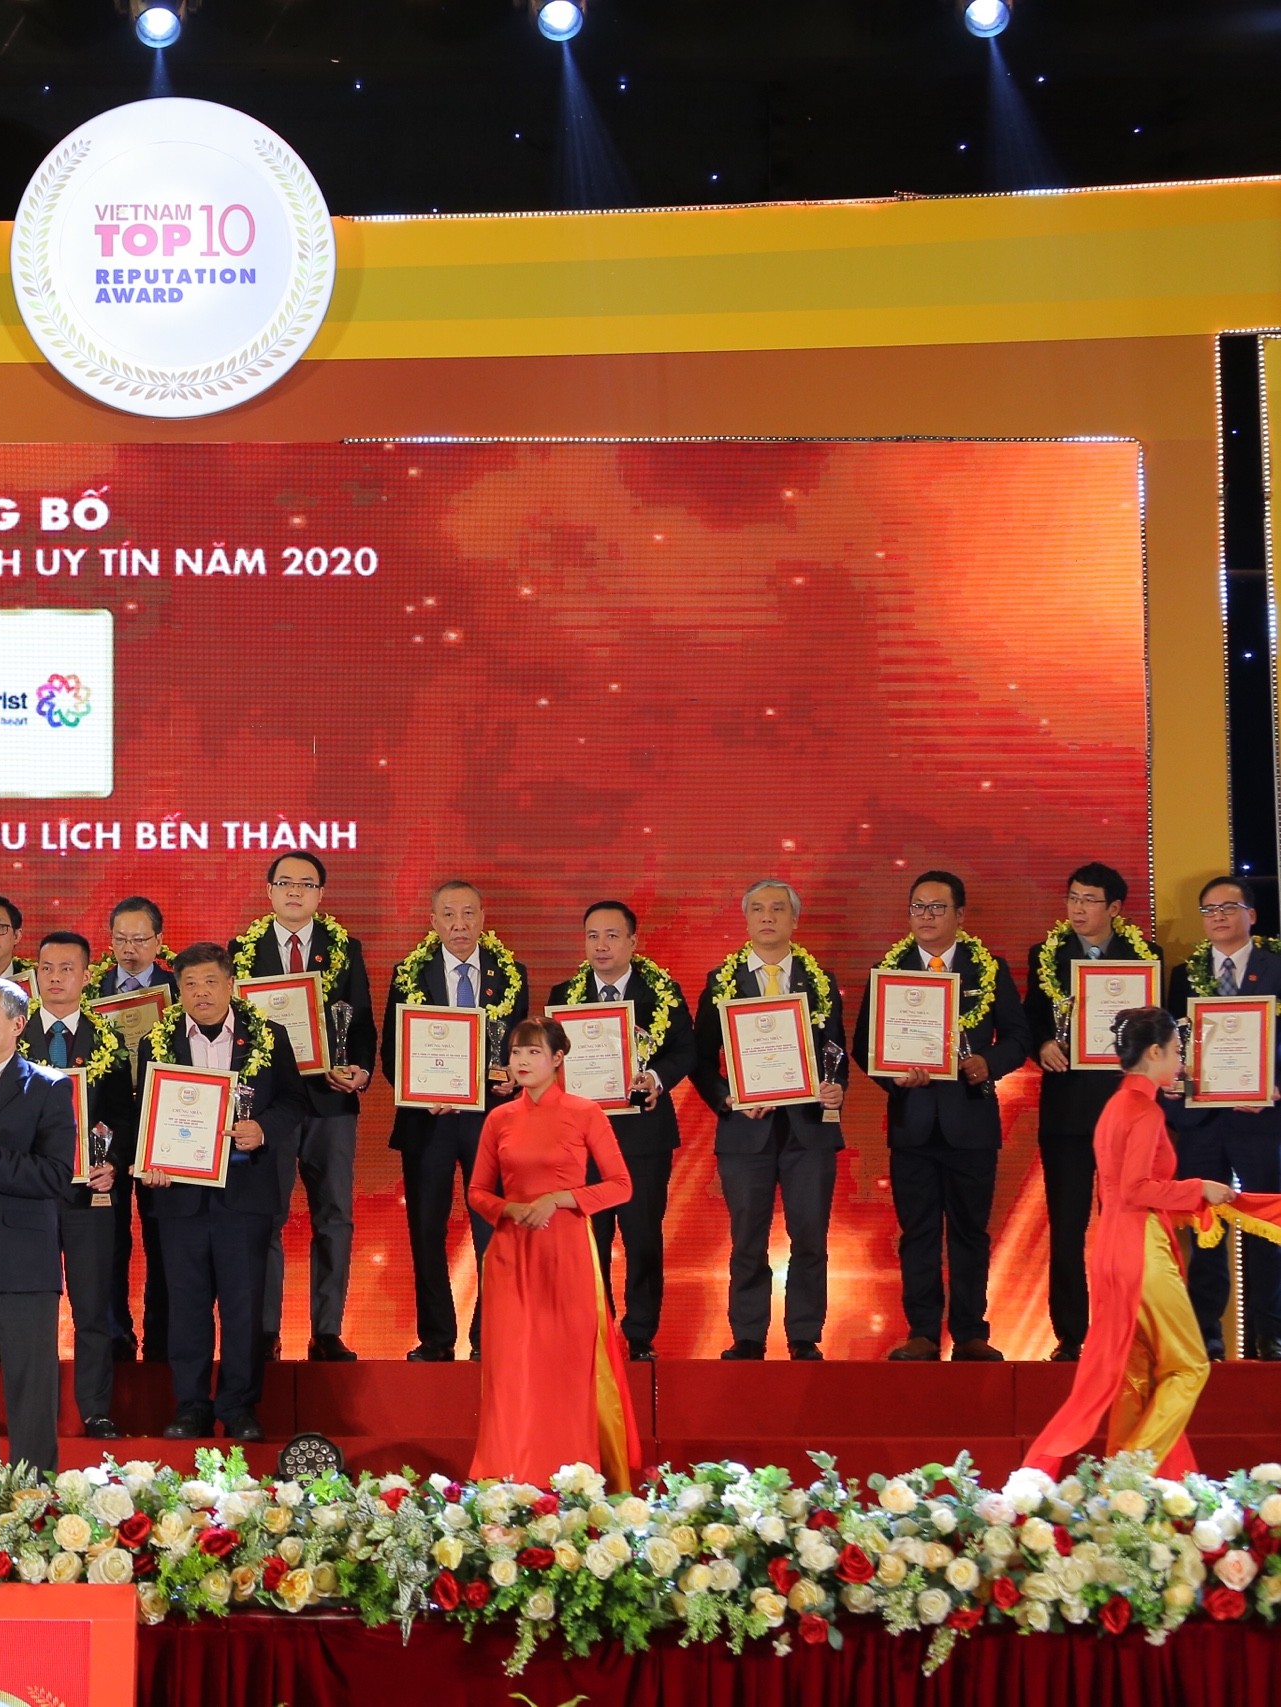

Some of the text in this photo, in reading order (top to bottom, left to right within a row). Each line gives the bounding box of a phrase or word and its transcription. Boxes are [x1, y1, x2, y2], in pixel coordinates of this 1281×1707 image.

[94, 203, 192, 221] VIETNAM
[94, 203, 256, 257] TOP 10
[95, 268, 257, 285] REPUTATION
[94, 287, 184, 304] AWARD
[40, 485, 110, 532] BỐ
[36, 548, 88, 577] UY
[99, 541, 160, 577] TÍN
[174, 542, 267, 576] NĂM
[282, 547, 379, 576] 2020
[41, 821, 120, 856] LỊCH
[136, 812, 209, 850] BẾN
[222, 813, 358, 849] THÀNH
